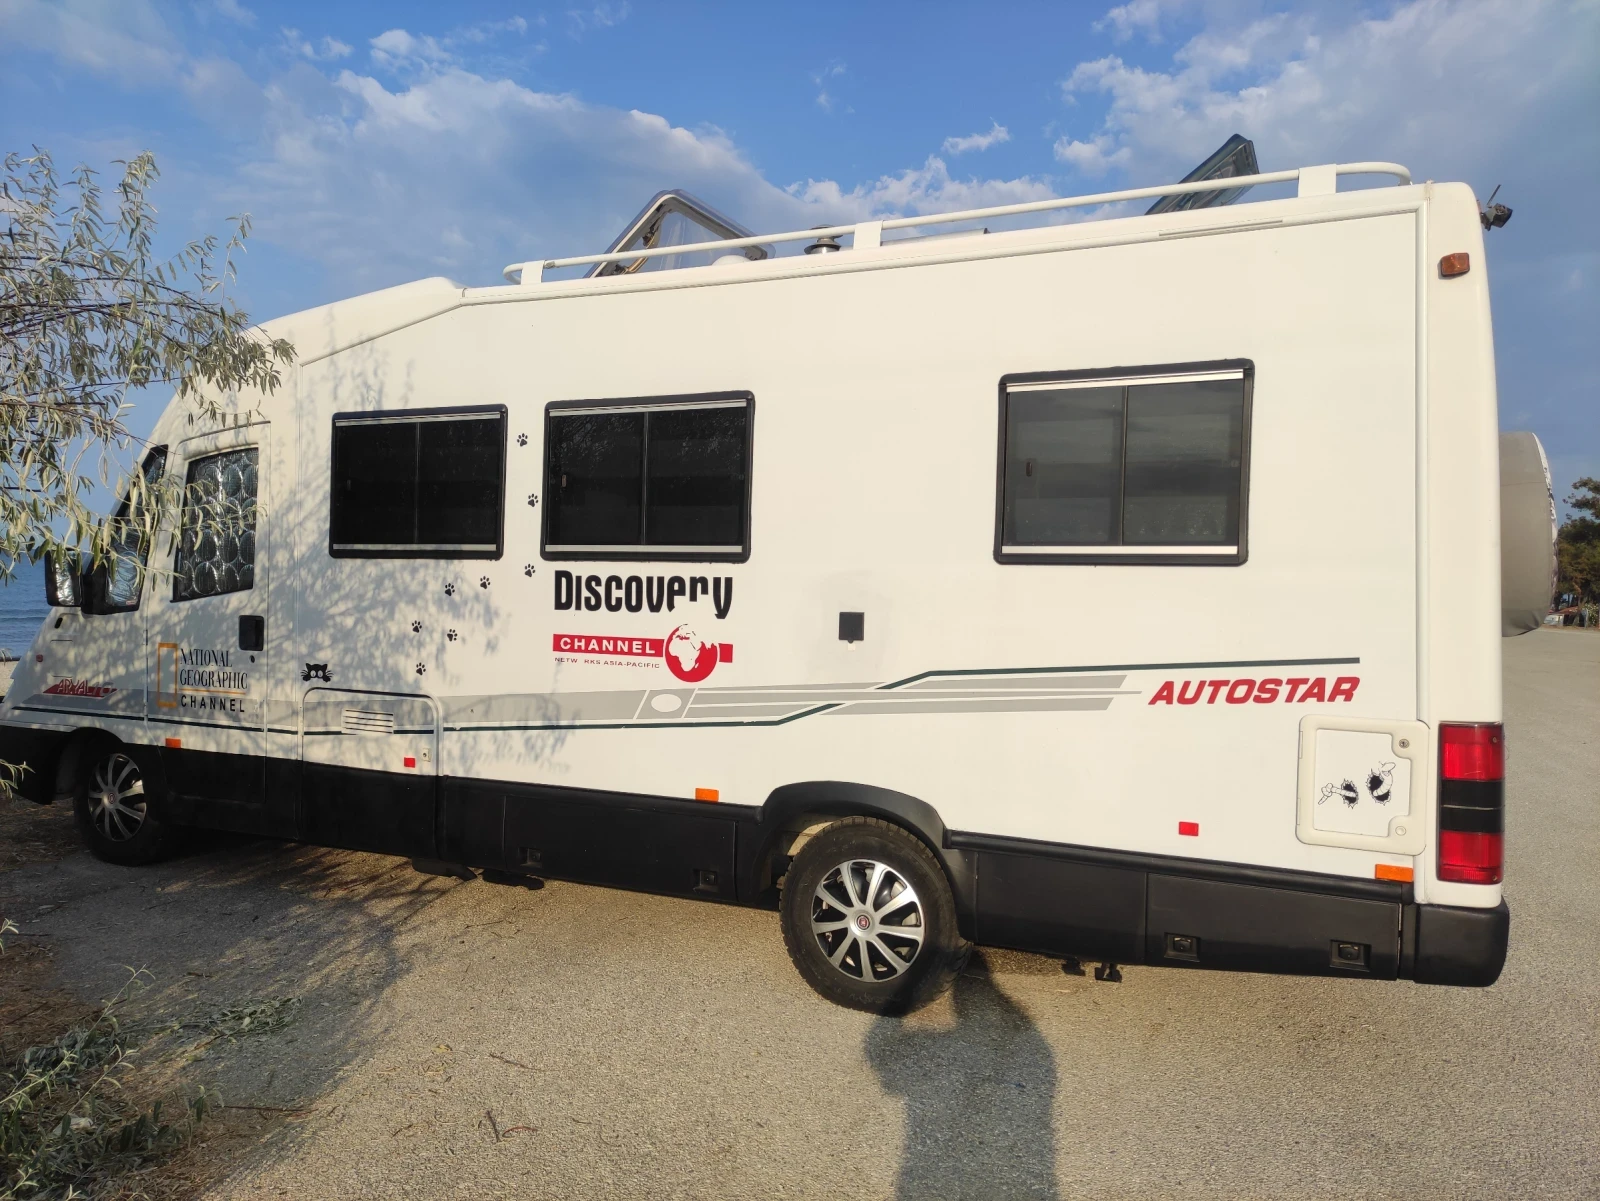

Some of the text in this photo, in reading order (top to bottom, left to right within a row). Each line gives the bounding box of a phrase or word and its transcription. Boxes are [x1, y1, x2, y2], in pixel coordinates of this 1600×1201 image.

[560, 637, 655, 654] CHANNEL
[180, 648, 232, 667] NATIONAL
[180, 669, 248, 689] GEOGRAPHIC
[1148, 676, 1361, 706] AUTOSTAR
[181, 694, 245, 713] CHANNEL
